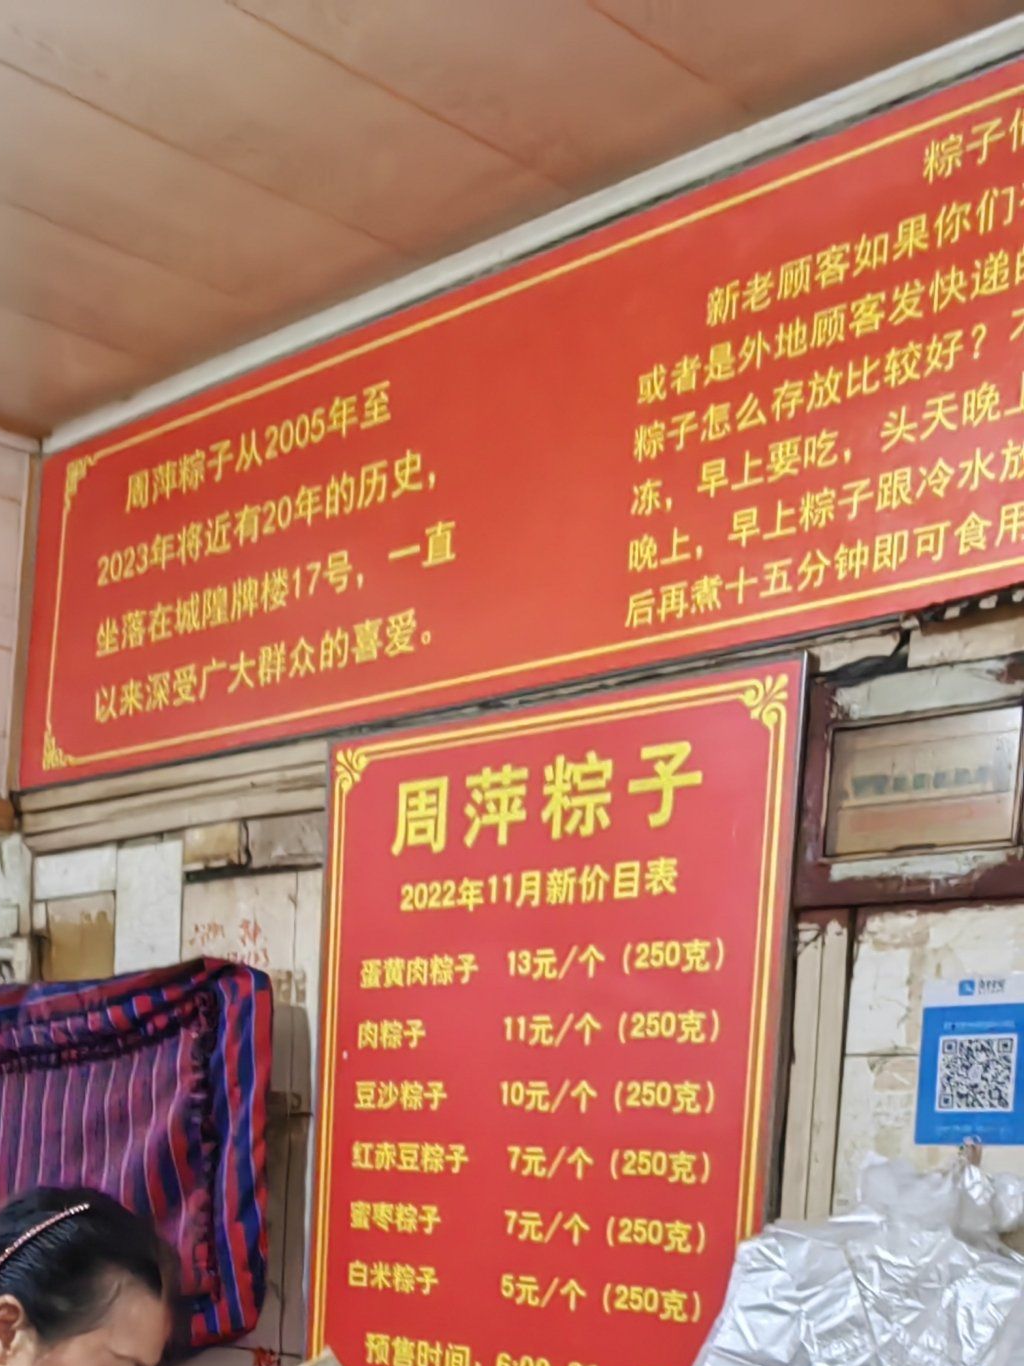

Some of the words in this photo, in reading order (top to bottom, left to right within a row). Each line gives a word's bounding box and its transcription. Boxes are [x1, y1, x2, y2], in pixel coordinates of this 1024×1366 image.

[706, 181, 1024, 327] 新老顾客如果你们
[125, 380, 392, 513] 周萍粽子从2005年至
[96, 448, 437, 587] 2023年将近有20年的历史，
[94, 607, 432, 724] 以来深受广大群众的喜爱。
[391, 740, 703, 857] 周萍粽子
[399, 856, 679, 913] 2022年11月新价目表
[359, 953, 479, 990] 蛋黄肉粽子
[357, 1018, 427, 1051] 肉粽子
[354, 1081, 448, 1112] 豆沙粽子
[351, 1140, 470, 1175] 红赤豆粽子
[349, 1200, 442, 1236] 蜜枣粽子
[347, 1259, 439, 1297] 白米粽子
